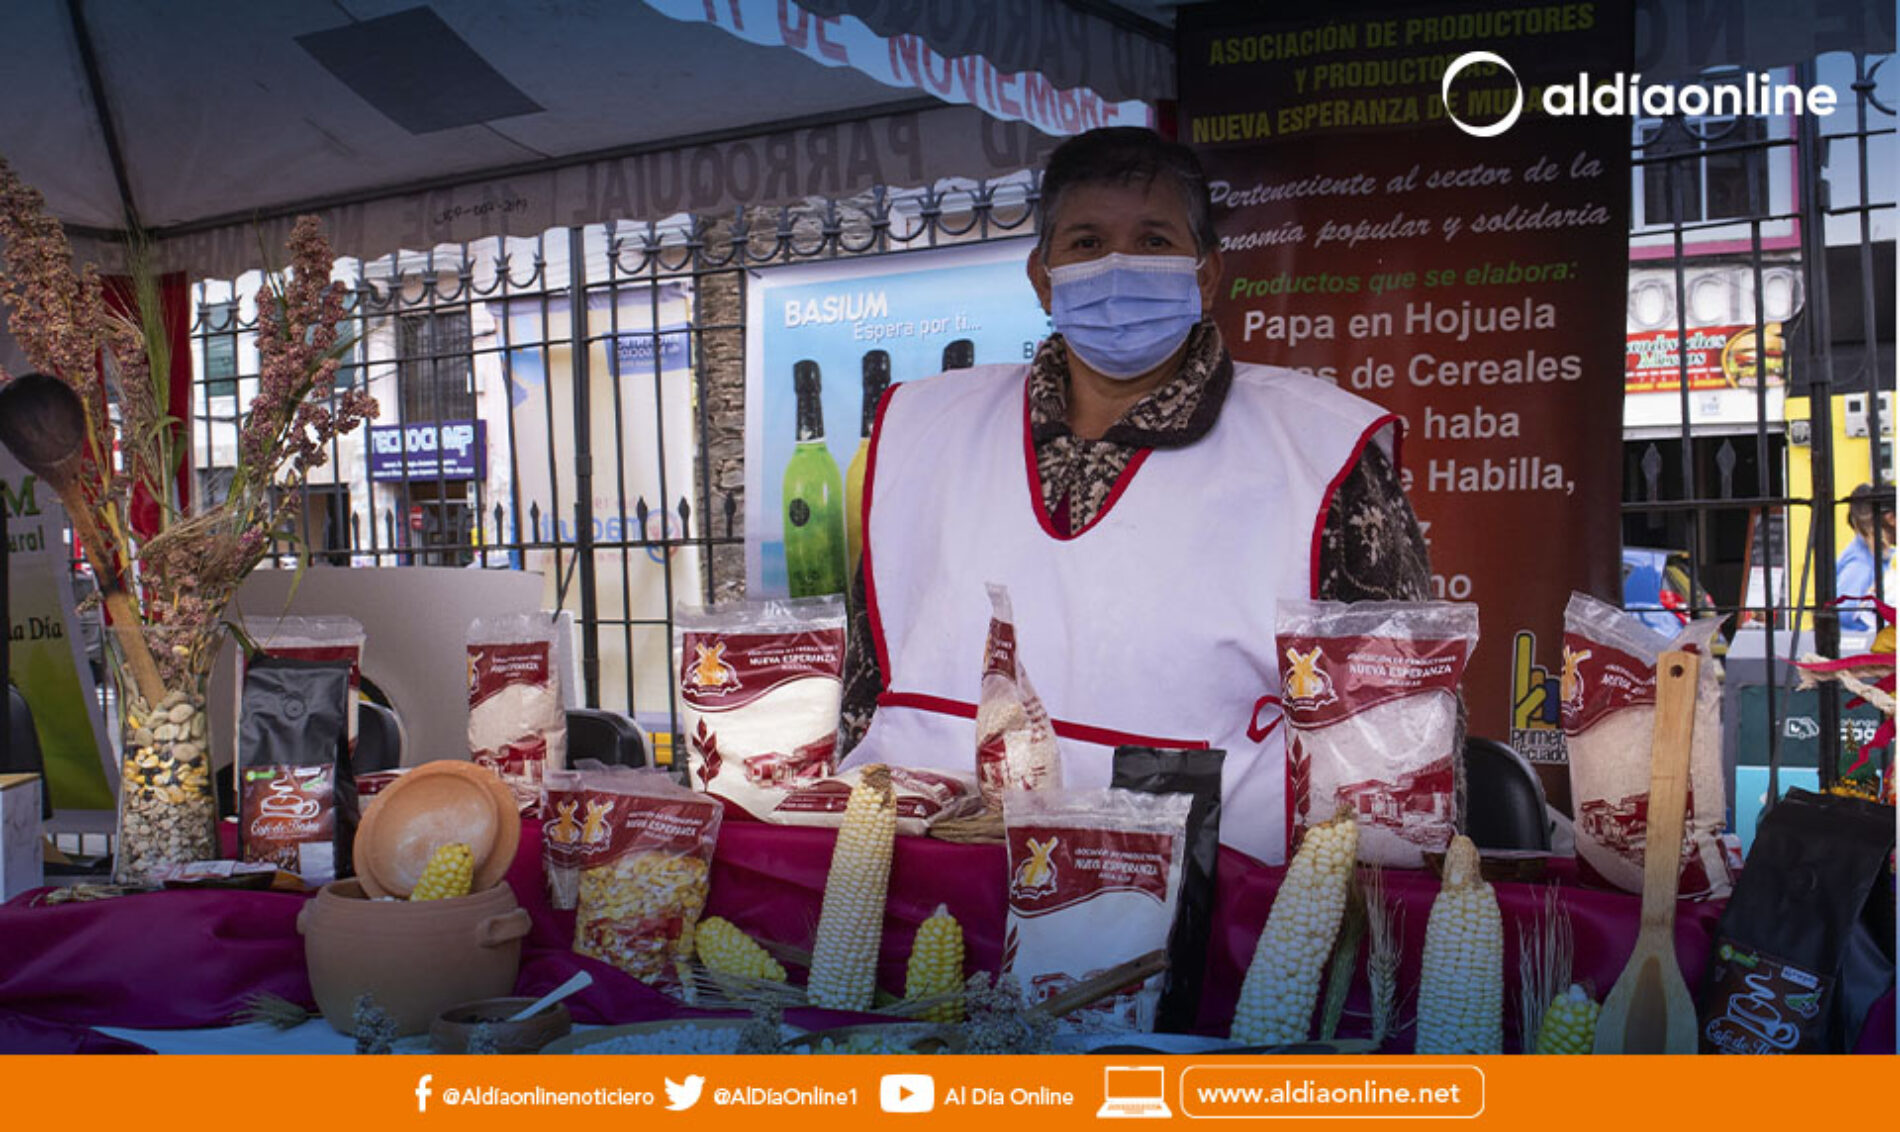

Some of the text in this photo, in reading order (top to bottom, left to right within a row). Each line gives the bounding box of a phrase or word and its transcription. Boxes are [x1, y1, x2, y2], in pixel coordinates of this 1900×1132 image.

[1209, 22, 1357, 66] ASOCIACIÓN
[1366, 22, 1398, 49] DE
[1404, 4, 1595, 43] PRODUCTORES
[1295, 52, 1498, 94] Y PRODUCTOAS
[1193, 109, 1271, 144] NUEVA
[1278, 94, 1420, 134] ESPERANZA
[1207, 150, 1604, 209] Perteneciente al sector de la
[1217, 201, 1611, 254] onomía popular y solidaria
[1229, 260, 1578, 301] Productos que se elabora:
[784, 291, 889, 328] BASIUM
[853, 318, 914, 343] Espera
[919, 314, 949, 340] por
[1243, 296, 1557, 348] Papa en Hojuela
[1350, 356, 1395, 390] de
[1408, 349, 1583, 388] Cereales
[1424, 404, 1520, 440] haba
[1428, 457, 1577, 496] Habilla,
[29, 616, 63, 640] Día
[750, 653, 838, 666] NUEVA ESPERANZA
[1349, 663, 1452, 678] NUEVA ESPERANZA
